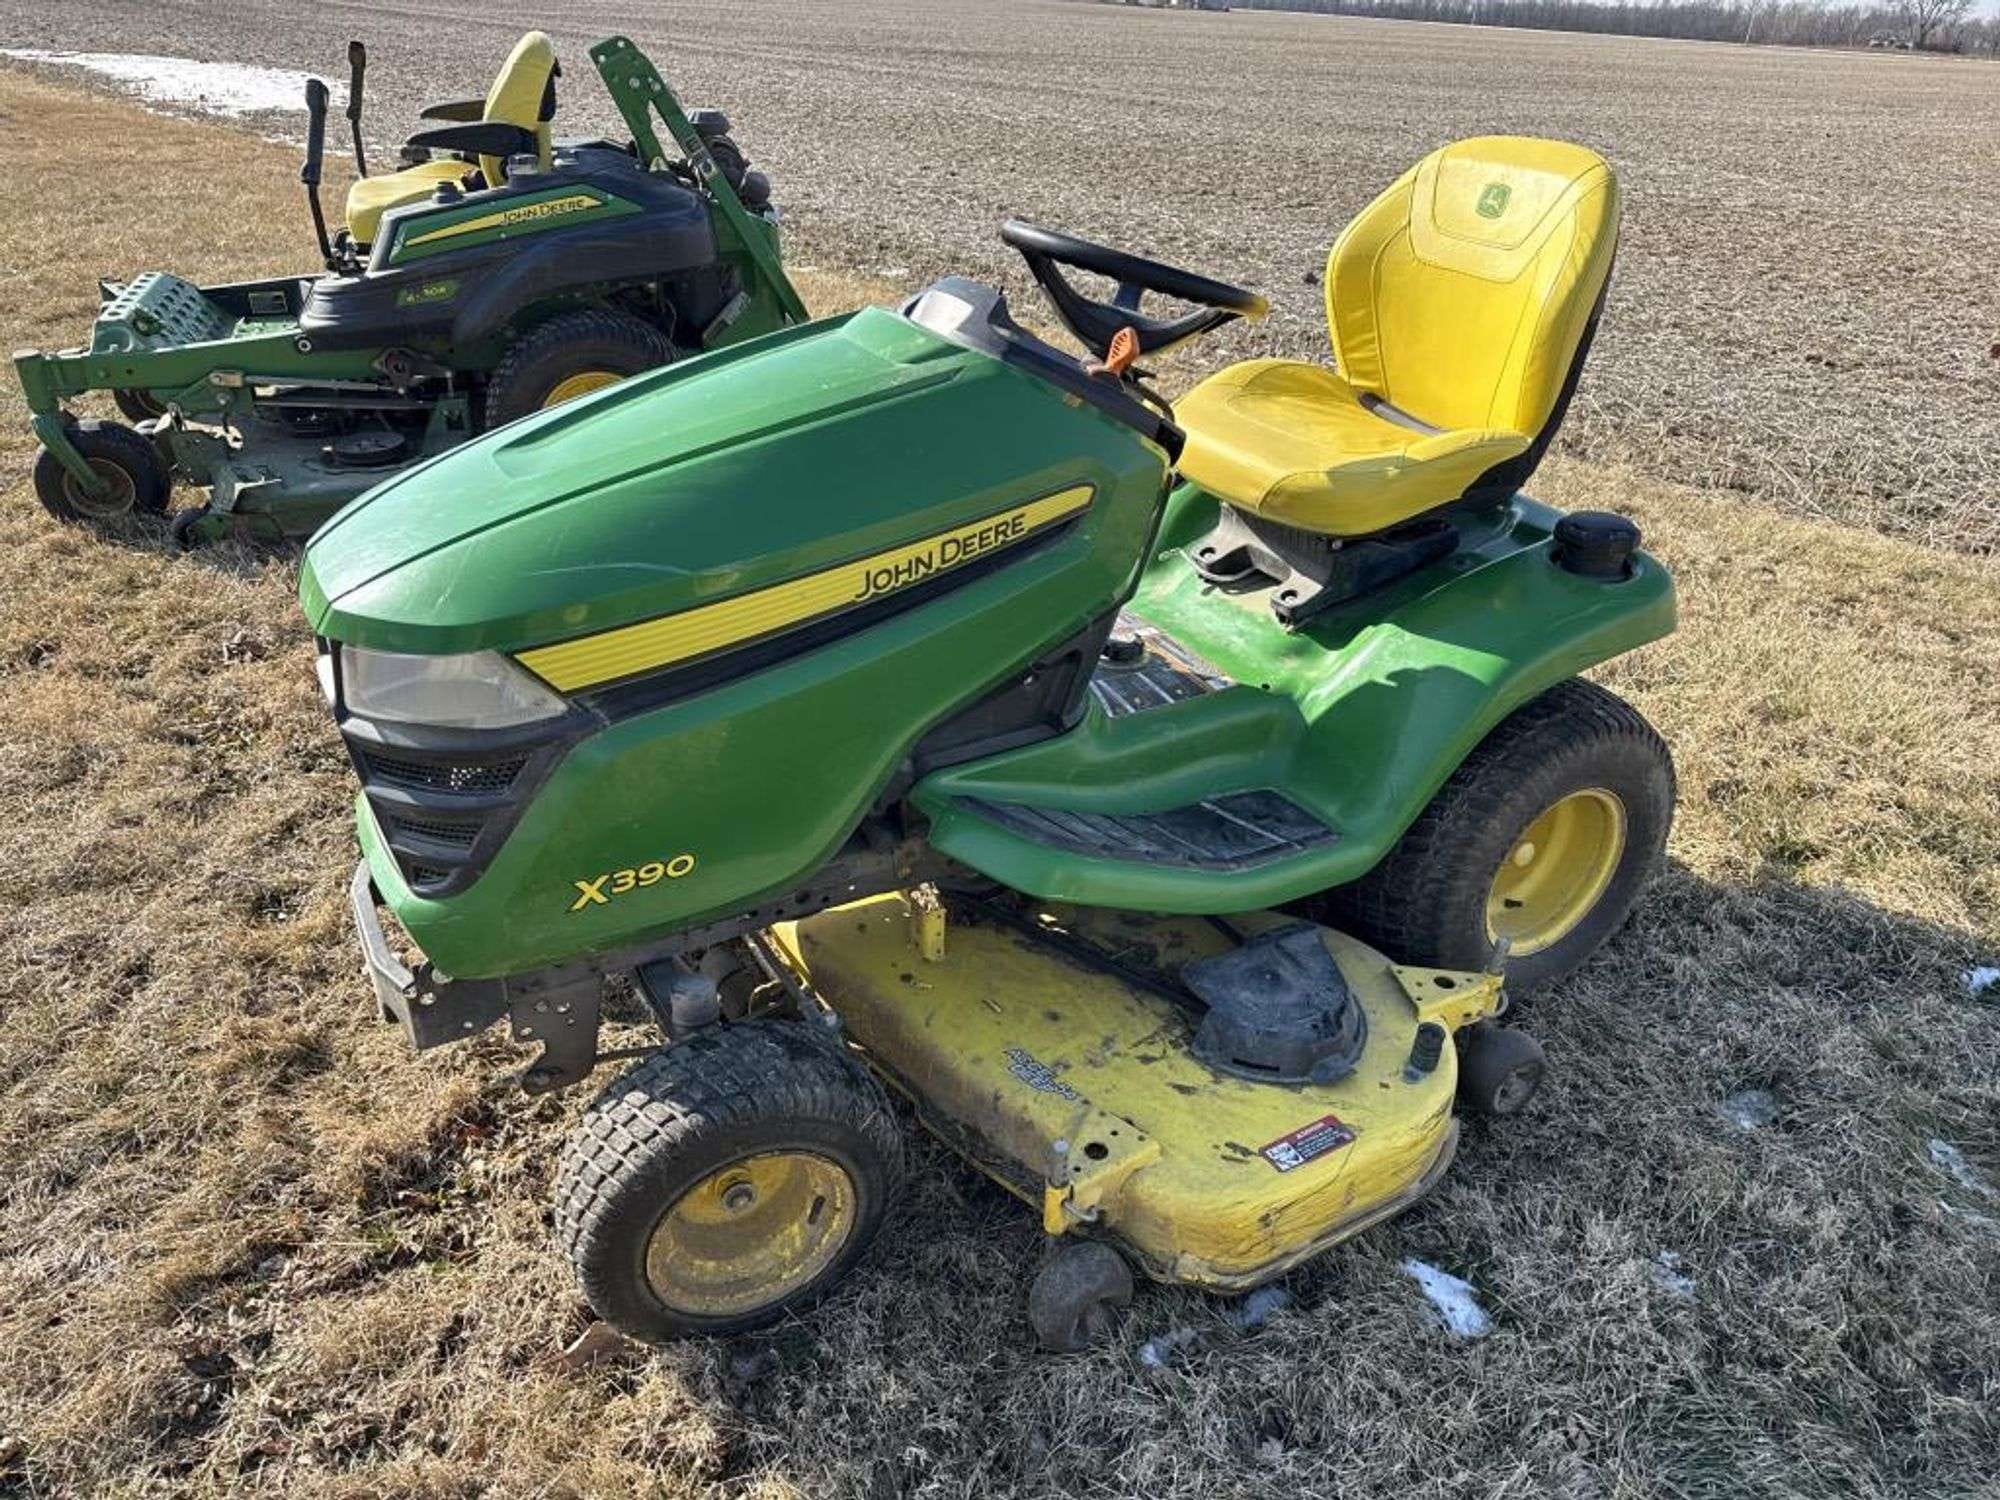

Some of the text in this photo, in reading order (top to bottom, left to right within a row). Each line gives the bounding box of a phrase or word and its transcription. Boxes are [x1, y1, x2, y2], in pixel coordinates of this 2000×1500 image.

[501, 199, 585, 225] JOHN DEERE
[855, 513, 1026, 599] JOHN DEERE
[568, 853, 696, 912] X390
